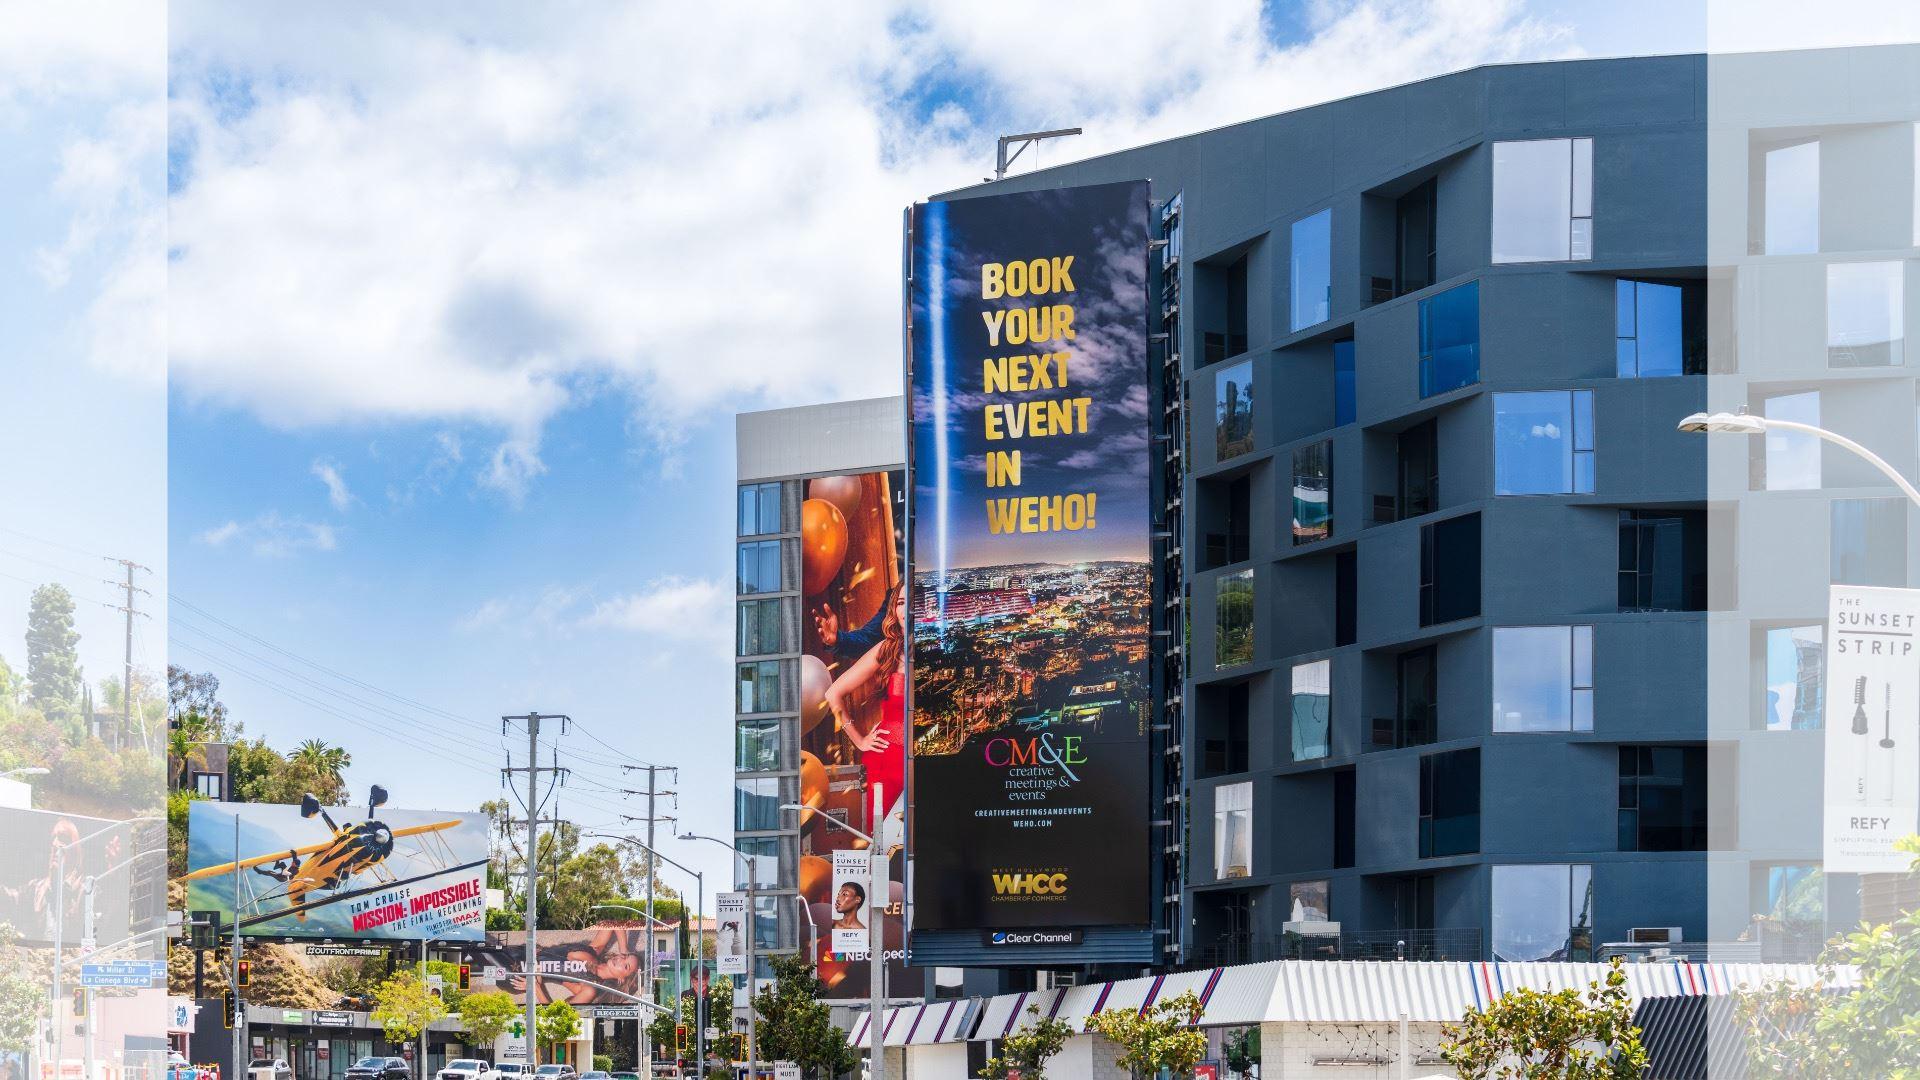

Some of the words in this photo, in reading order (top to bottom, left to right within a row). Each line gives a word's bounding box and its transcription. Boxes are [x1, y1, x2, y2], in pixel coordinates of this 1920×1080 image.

[982, 256, 1075, 300] BOOK
[982, 305, 1076, 347] YOUR
[984, 352, 1071, 394] NEXT
[985, 398, 1092, 440] EVENT
[986, 450, 1021, 488] IN
[986, 492, 1097, 535] WEHO!
[1838, 598, 1861, 606] THE
[1838, 611, 1915, 628] SUNSET
[1838, 638, 1913, 656] STRIP
[984, 732, 1088, 782] CM&E
[1009, 764, 1055, 777] creative
[1005, 776, 1058, 791] meetings
[1058, 775, 1071, 788] &
[1008, 790, 1047, 801] events
[974, 807, 1093, 818] CREATIVEMEETINGSANDEVENTS
[1013, 820, 1053, 828] WEHO.COM
[1850, 816, 1891, 830] REFY
[992, 873, 1068, 895] WHCC
[351, 899, 370, 913] TOM
[375, 888, 411, 906] CRUISE
[352, 901, 408, 934] MISSION:
[409, 878, 480, 916] IMPOSSIBLE
[392, 920, 406, 932] THE
[411, 911, 433, 926] FINAL
[437, 897, 482, 917] RECKONING
[452, 910, 480, 924] IMAX
[1006, 933, 1032, 943] Clear
[1033, 932, 1072, 942] Channel
[306, 946, 380, 956] #OUTFRONTPRIME
[106, 966, 126, 974] Miller
[128, 966, 136, 974] Dr
[563, 960, 588, 973] FOX
[94, 976, 121, 985] Cienega
[123, 976, 139, 984] Blvd
